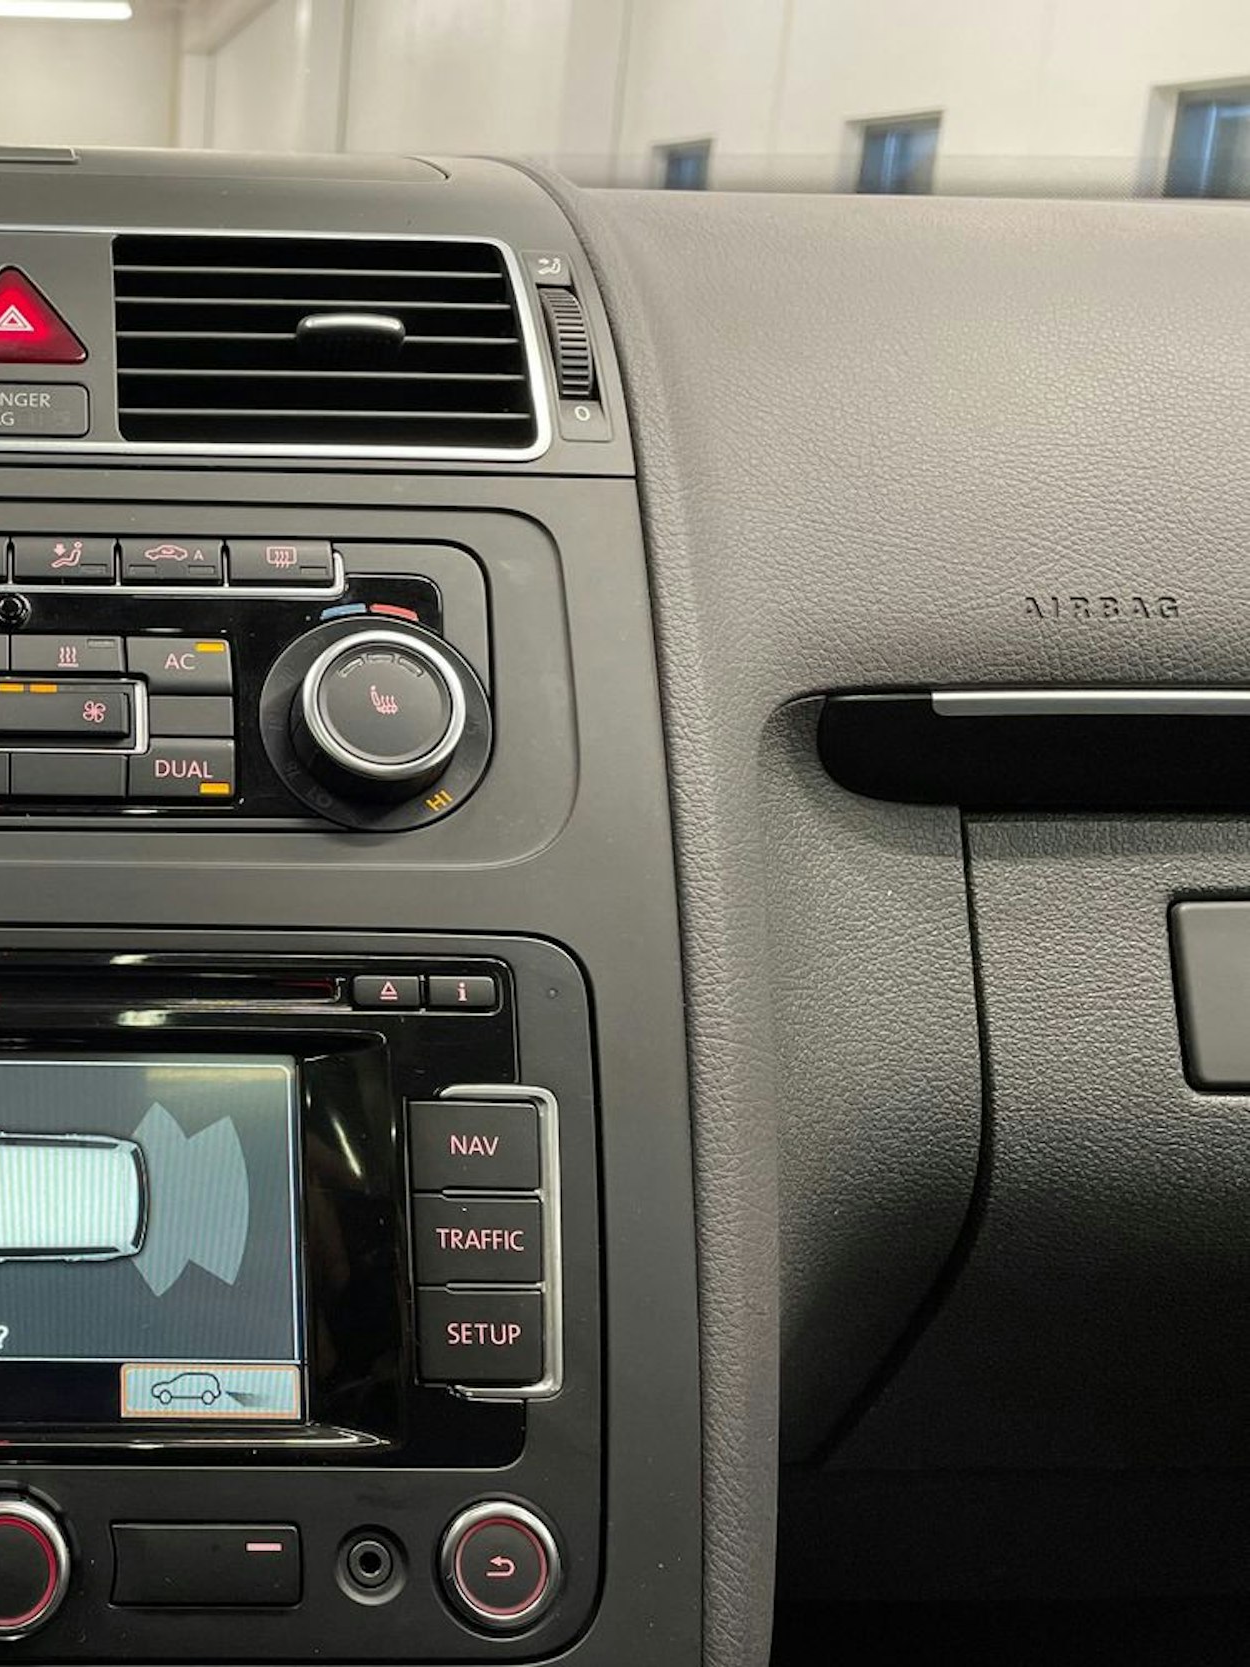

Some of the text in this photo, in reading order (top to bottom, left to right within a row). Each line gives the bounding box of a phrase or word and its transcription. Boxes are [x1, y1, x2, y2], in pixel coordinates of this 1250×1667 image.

[193, 549, 204, 562] A
[1025, 597, 1179, 618] AIRBAG
[164, 653, 195, 670] AC
[155, 760, 213, 779] DUAL
[427, 790, 453, 812] HI
[450, 1135, 499, 1156] NAV
[436, 1228, 525, 1251] TRAFFIC
[447, 1323, 521, 1346] SETUP
